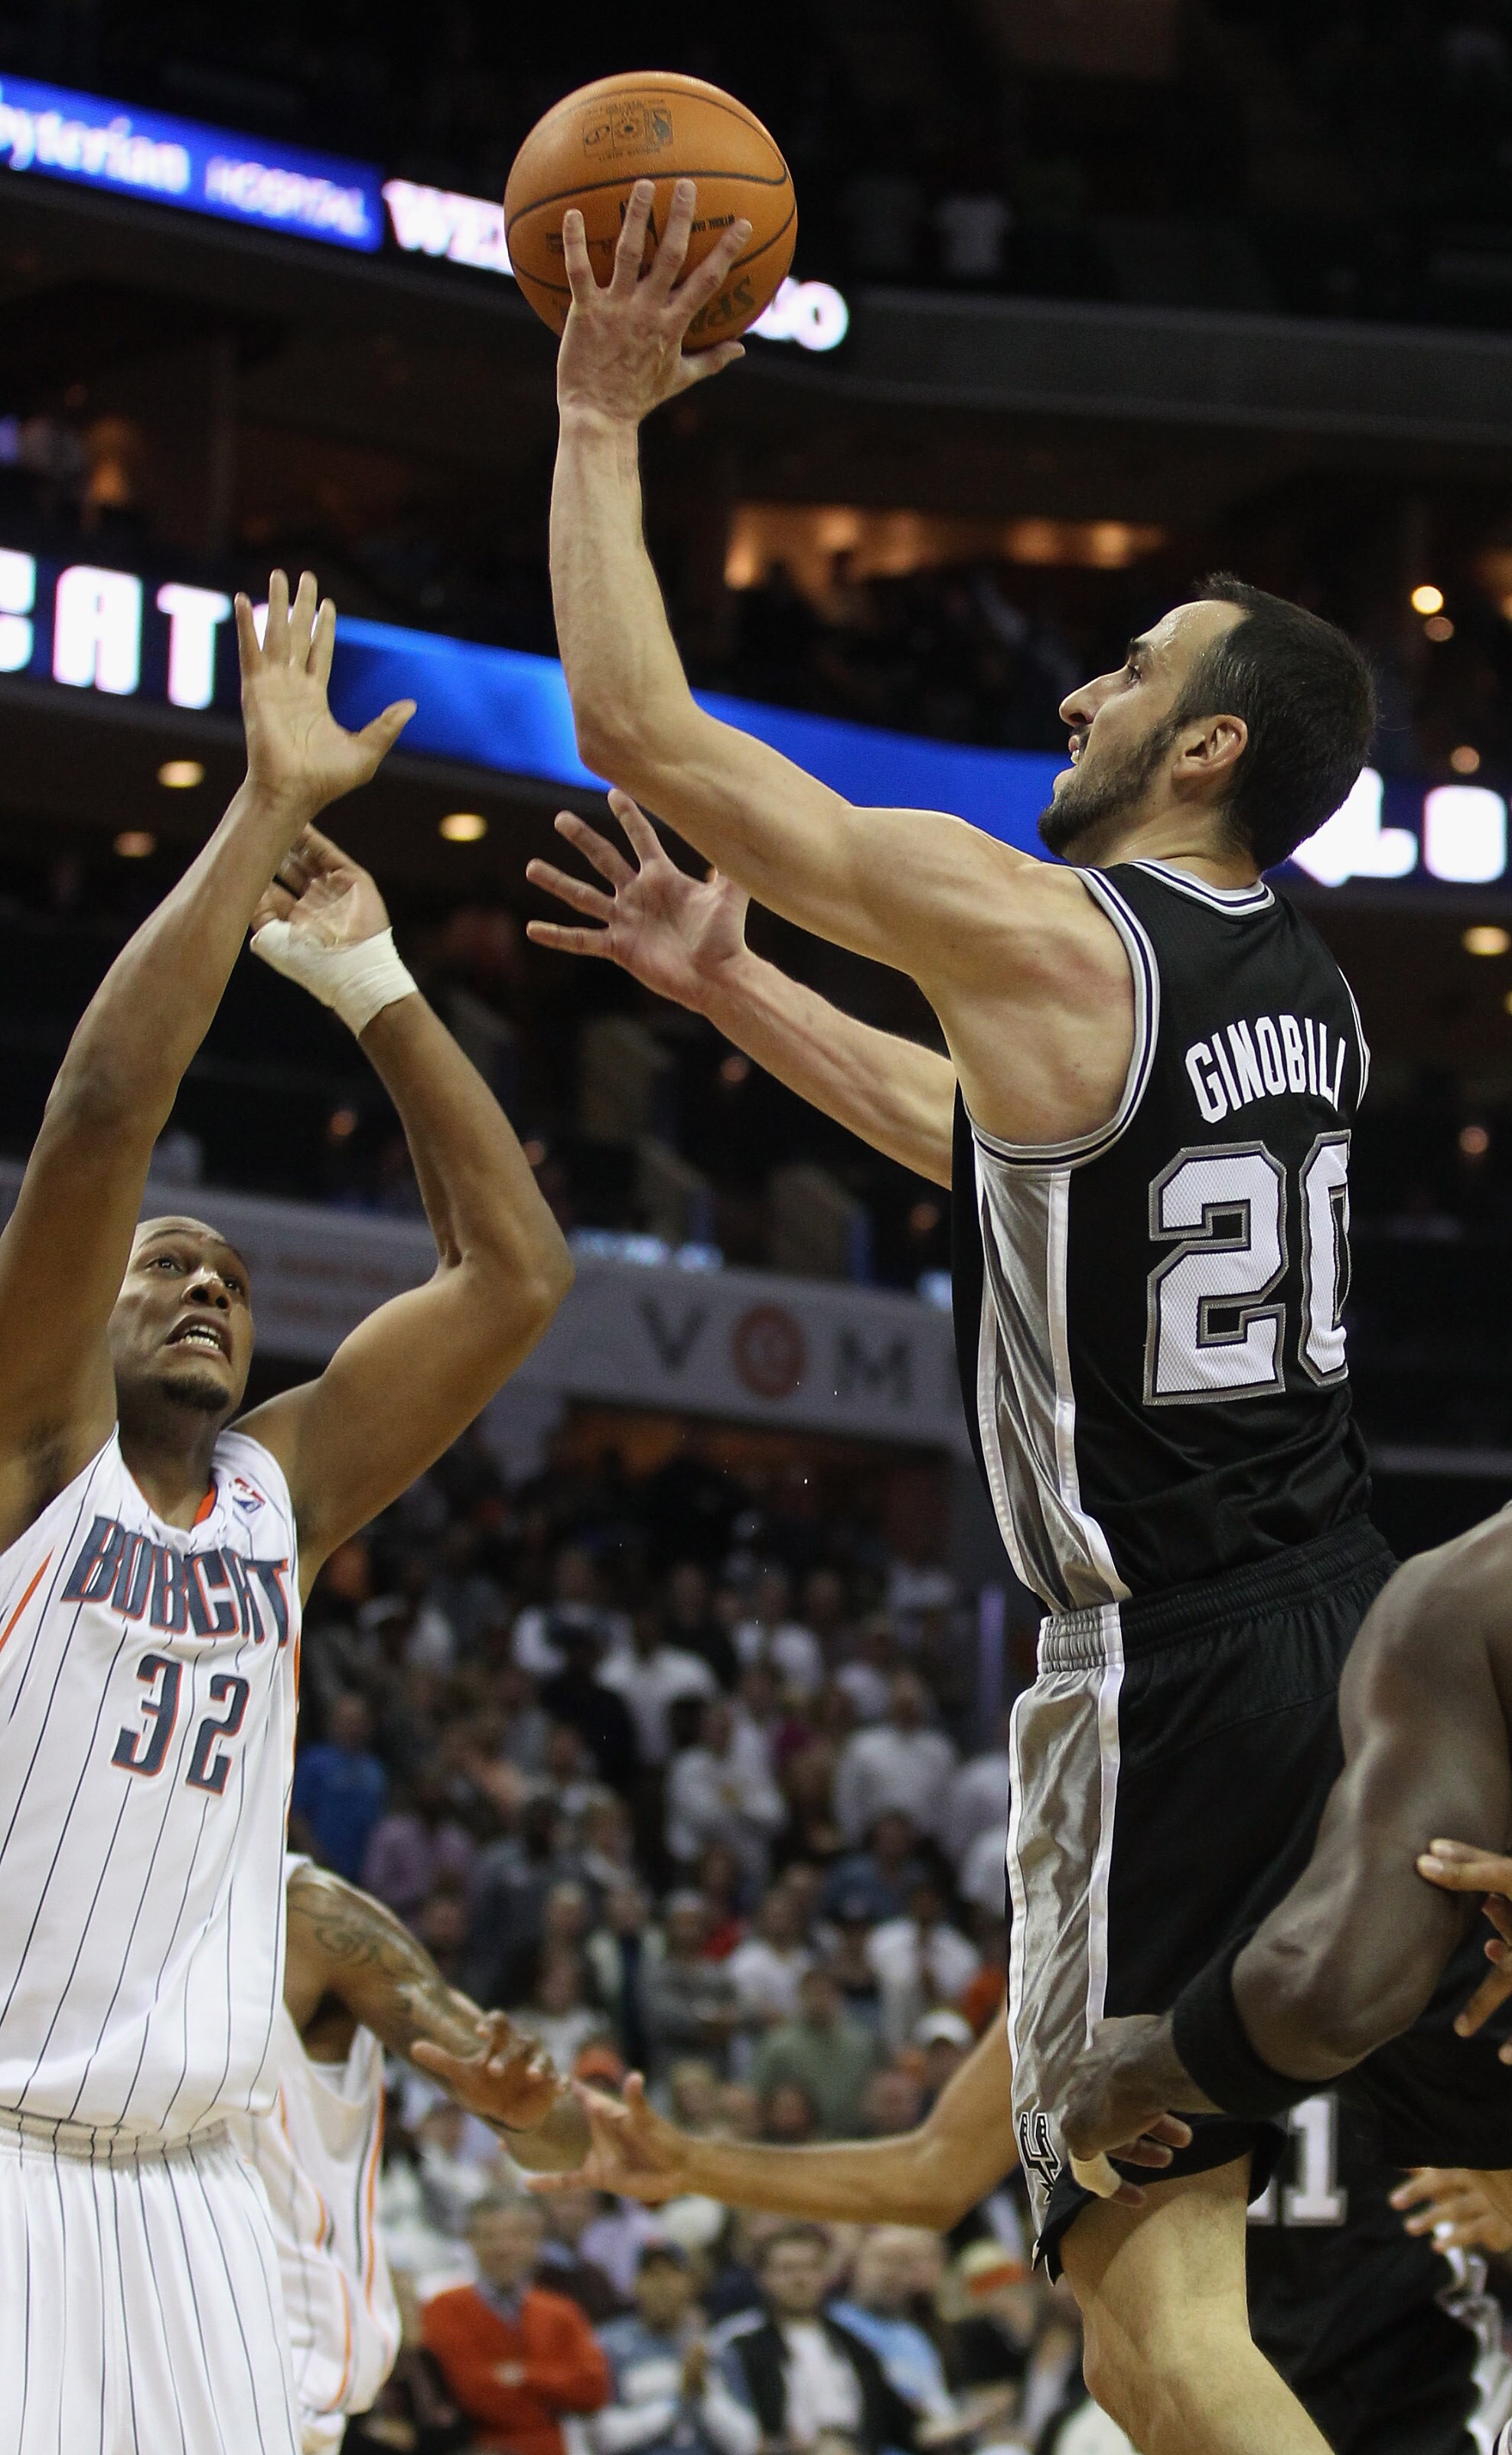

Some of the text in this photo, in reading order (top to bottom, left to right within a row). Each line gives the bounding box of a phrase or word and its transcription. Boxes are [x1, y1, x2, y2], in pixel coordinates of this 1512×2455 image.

[1185, 1014, 1347, 1123] GINOBILI
[1143, 1129, 1351, 1406] 20
[110, 1652, 249, 1796] 32
[1246, 2092, 1347, 2226] 1
